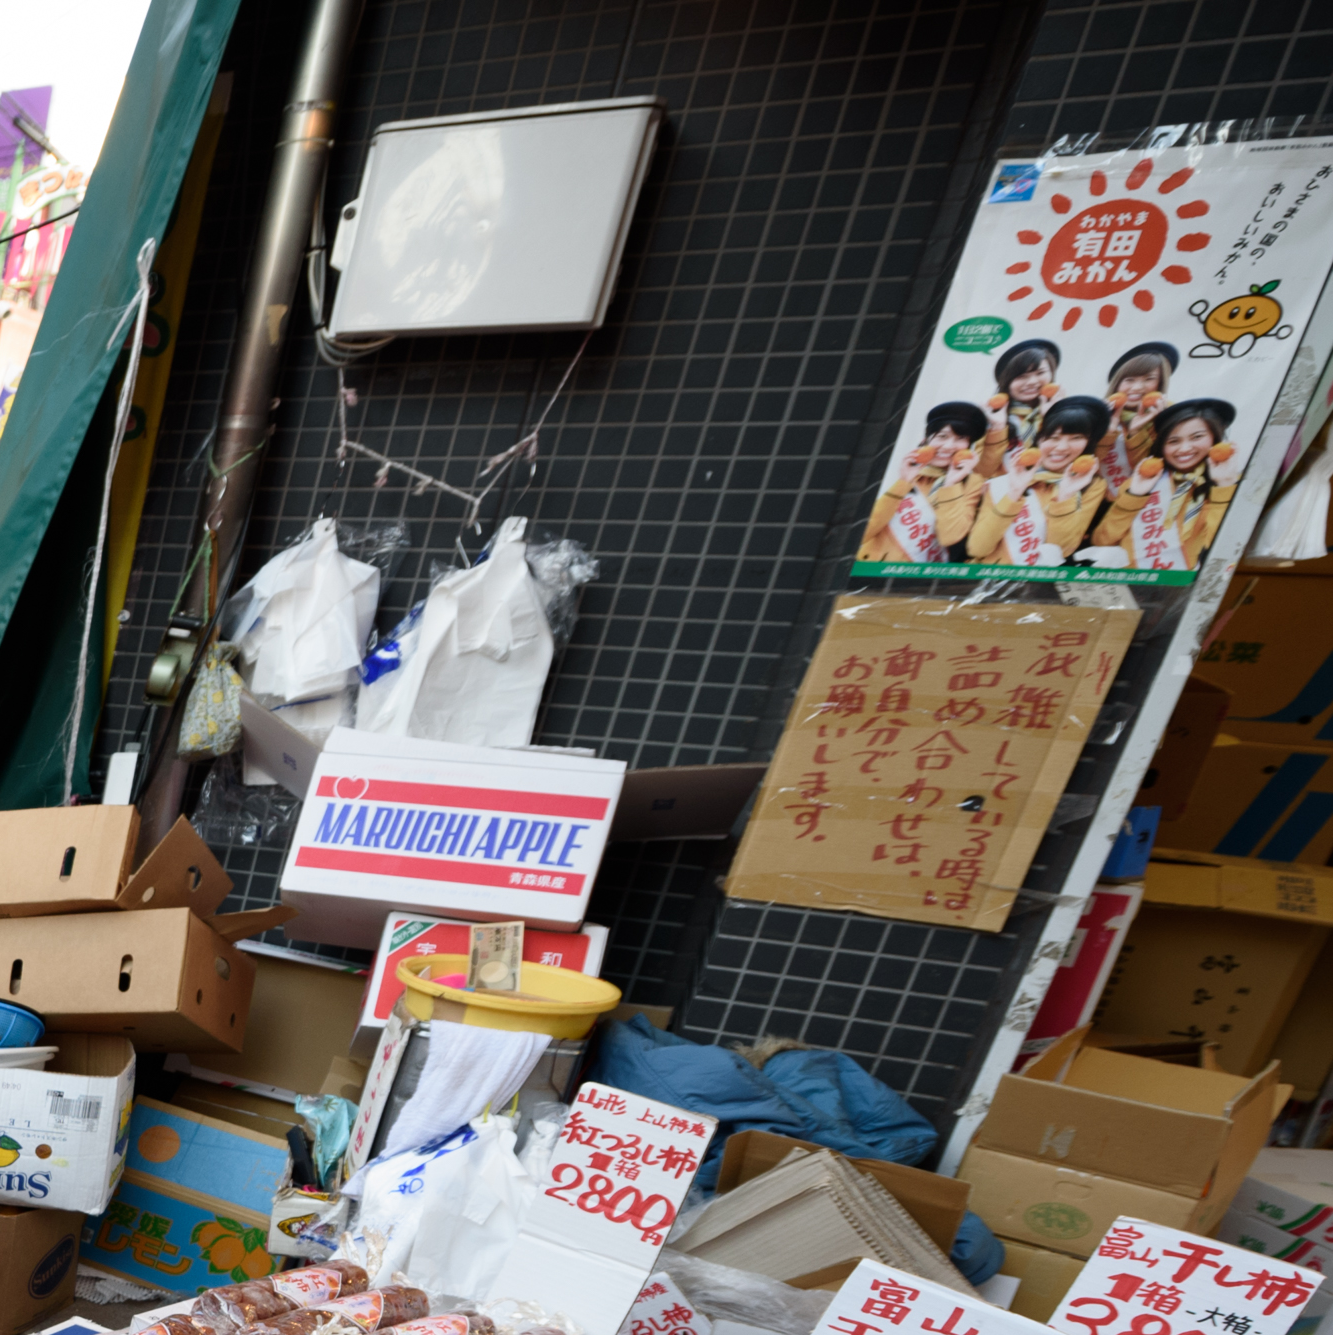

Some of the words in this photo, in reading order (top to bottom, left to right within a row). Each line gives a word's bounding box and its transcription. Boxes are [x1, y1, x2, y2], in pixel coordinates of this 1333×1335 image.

[1081, 210, 1149, 228] わかやま
[1073, 230, 1142, 259] 有田
[1052, 259, 1138, 285] みかん
[314, 803, 481, 858] MARUICHI
[472, 816, 591, 868] APPLE
[508, 872, 567, 890] 青森県産
[577, 1088, 628, 1116] 山形
[560, 1111, 698, 1180] 紅つるし柿
[586, 1151, 643, 1181] 1箱
[95, 1219, 194, 1276] レモン
[32, 1245, 75, 1291] Sunkist
[1097, 1225, 1159, 1269] 富山
[1162, 1240, 1316, 1316] 干し柿
[1102, 1272, 1186, 1315] 1箱
